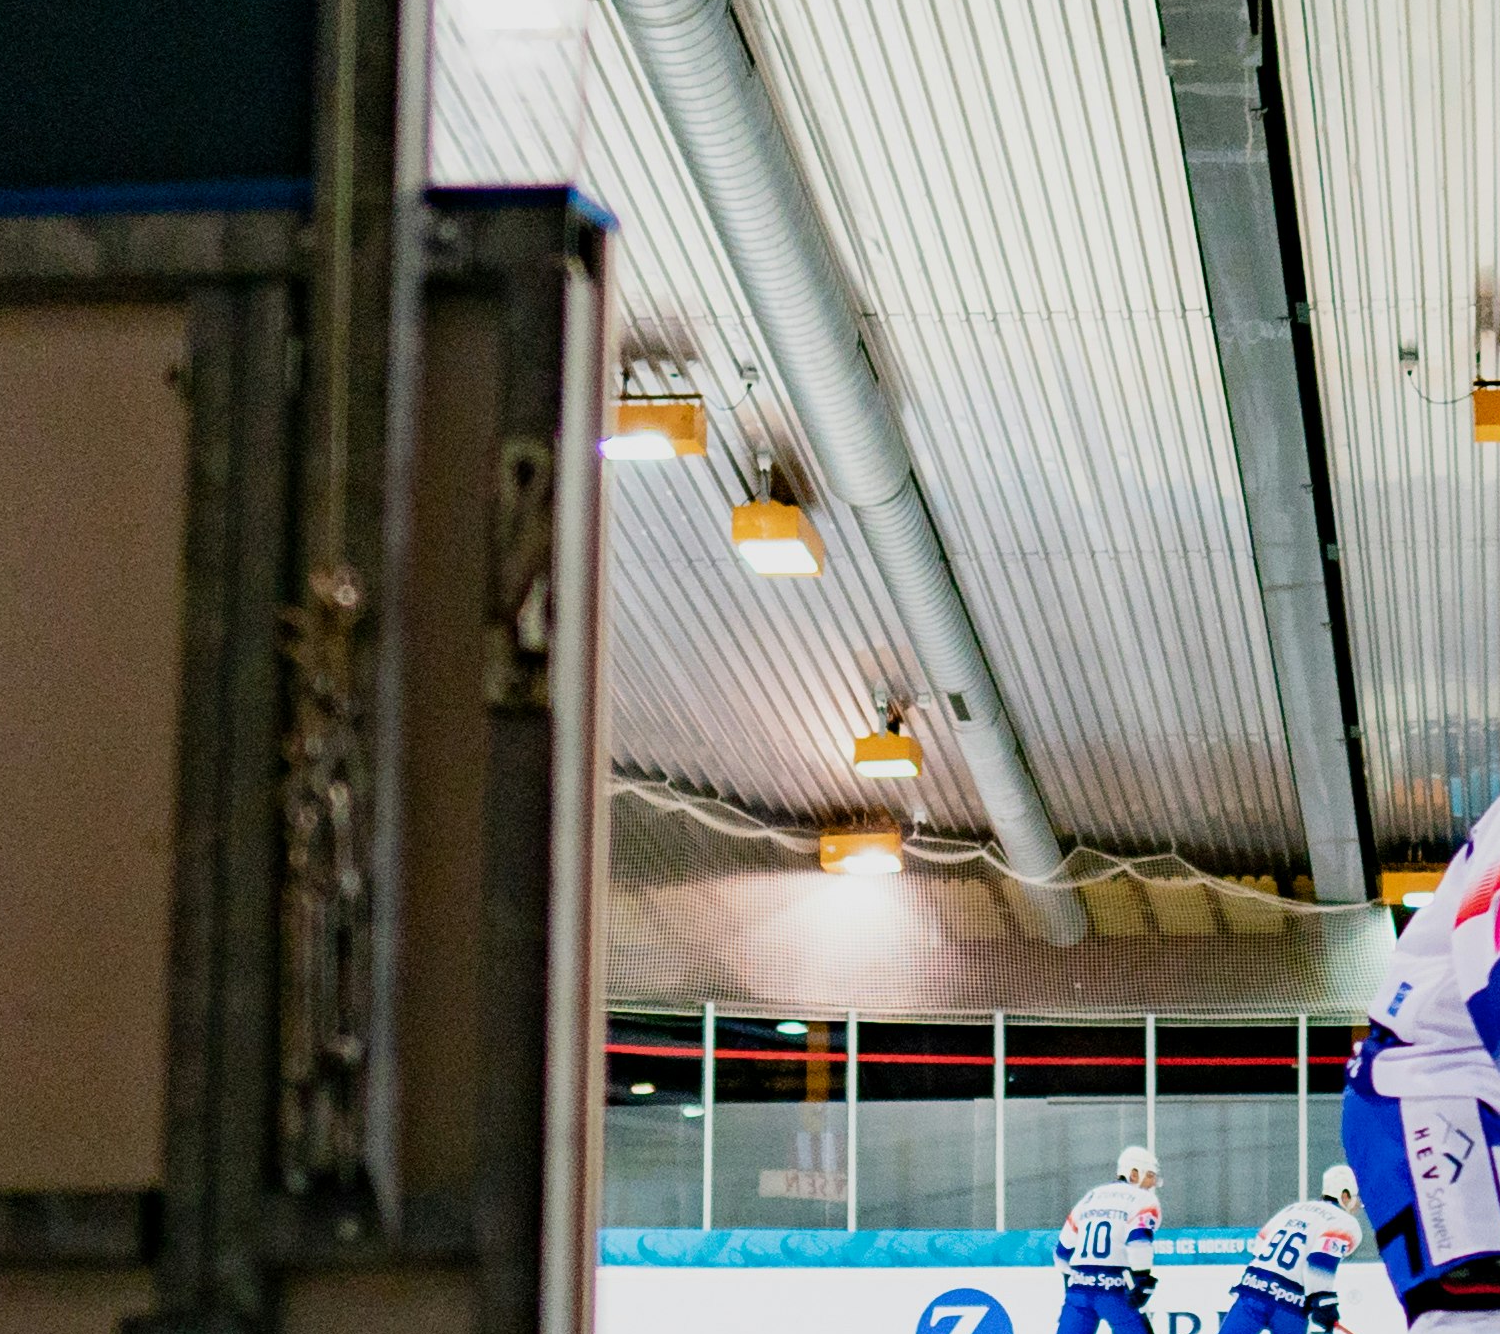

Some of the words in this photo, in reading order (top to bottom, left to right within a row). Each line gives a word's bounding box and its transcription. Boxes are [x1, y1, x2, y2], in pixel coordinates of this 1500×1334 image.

[1080, 1220, 1112, 1260] 10
[1176, 1238, 1196, 1255] ICE
[1197, 1238, 1245, 1255] HOCKEY
[1258, 1229, 1308, 1272] 96
[1242, 1272, 1269, 1292] blue
[1268, 1281, 1307, 1308] Sport
